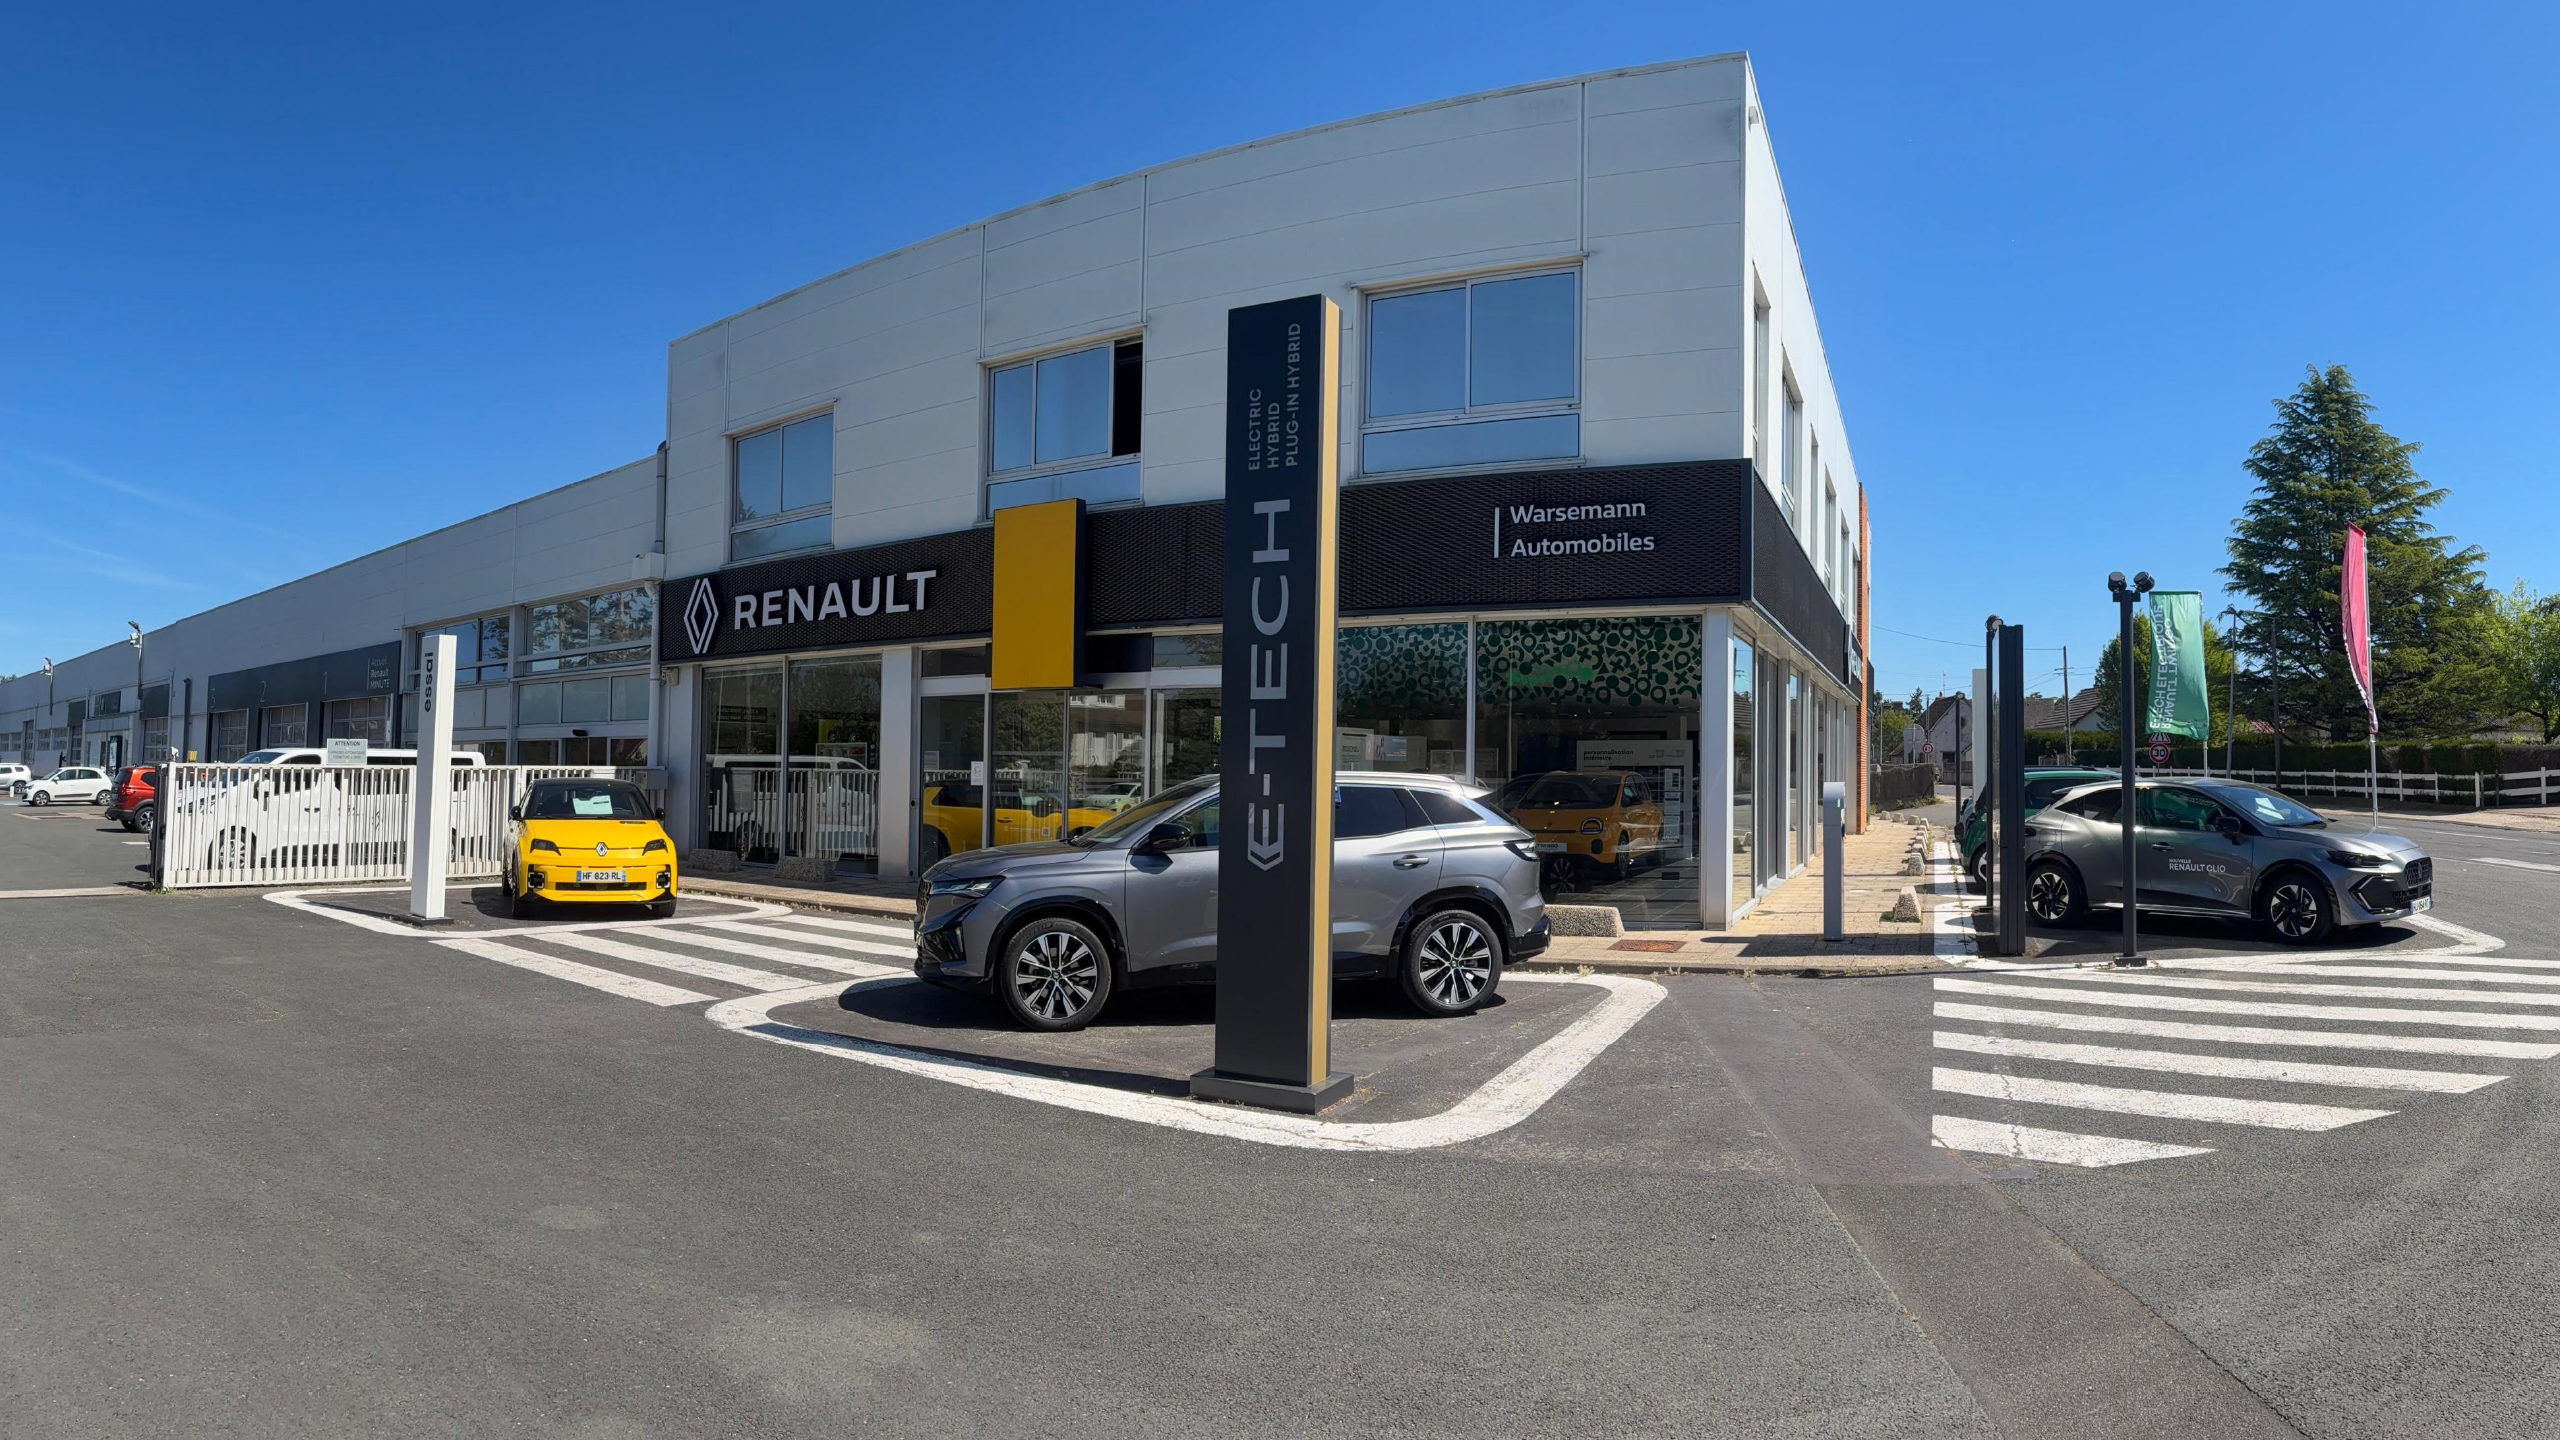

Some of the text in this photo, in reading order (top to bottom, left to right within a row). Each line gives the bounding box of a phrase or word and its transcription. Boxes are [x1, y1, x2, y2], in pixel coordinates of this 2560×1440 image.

[1286, 323, 1301, 467] PLUG-IN HYBRID
[1248, 388, 1262, 471] ELECTRIC
[1267, 402, 1280, 469] HYBRID
[1510, 502, 1646, 524] Warsemann
[1510, 532, 1655, 557] Automobiles
[734, 569, 937, 630] RENAULT
[370, 678, 391, 690] MINUTE
[371, 667, 389, 678] Renault
[425, 652, 434, 713] essai
[1247, 499, 1290, 871] E-TECH
[260, 680, 267, 702] 2
[2154, 749, 2166, 757] 30
[2169, 863, 2226, 873] RENAULT CLIO
